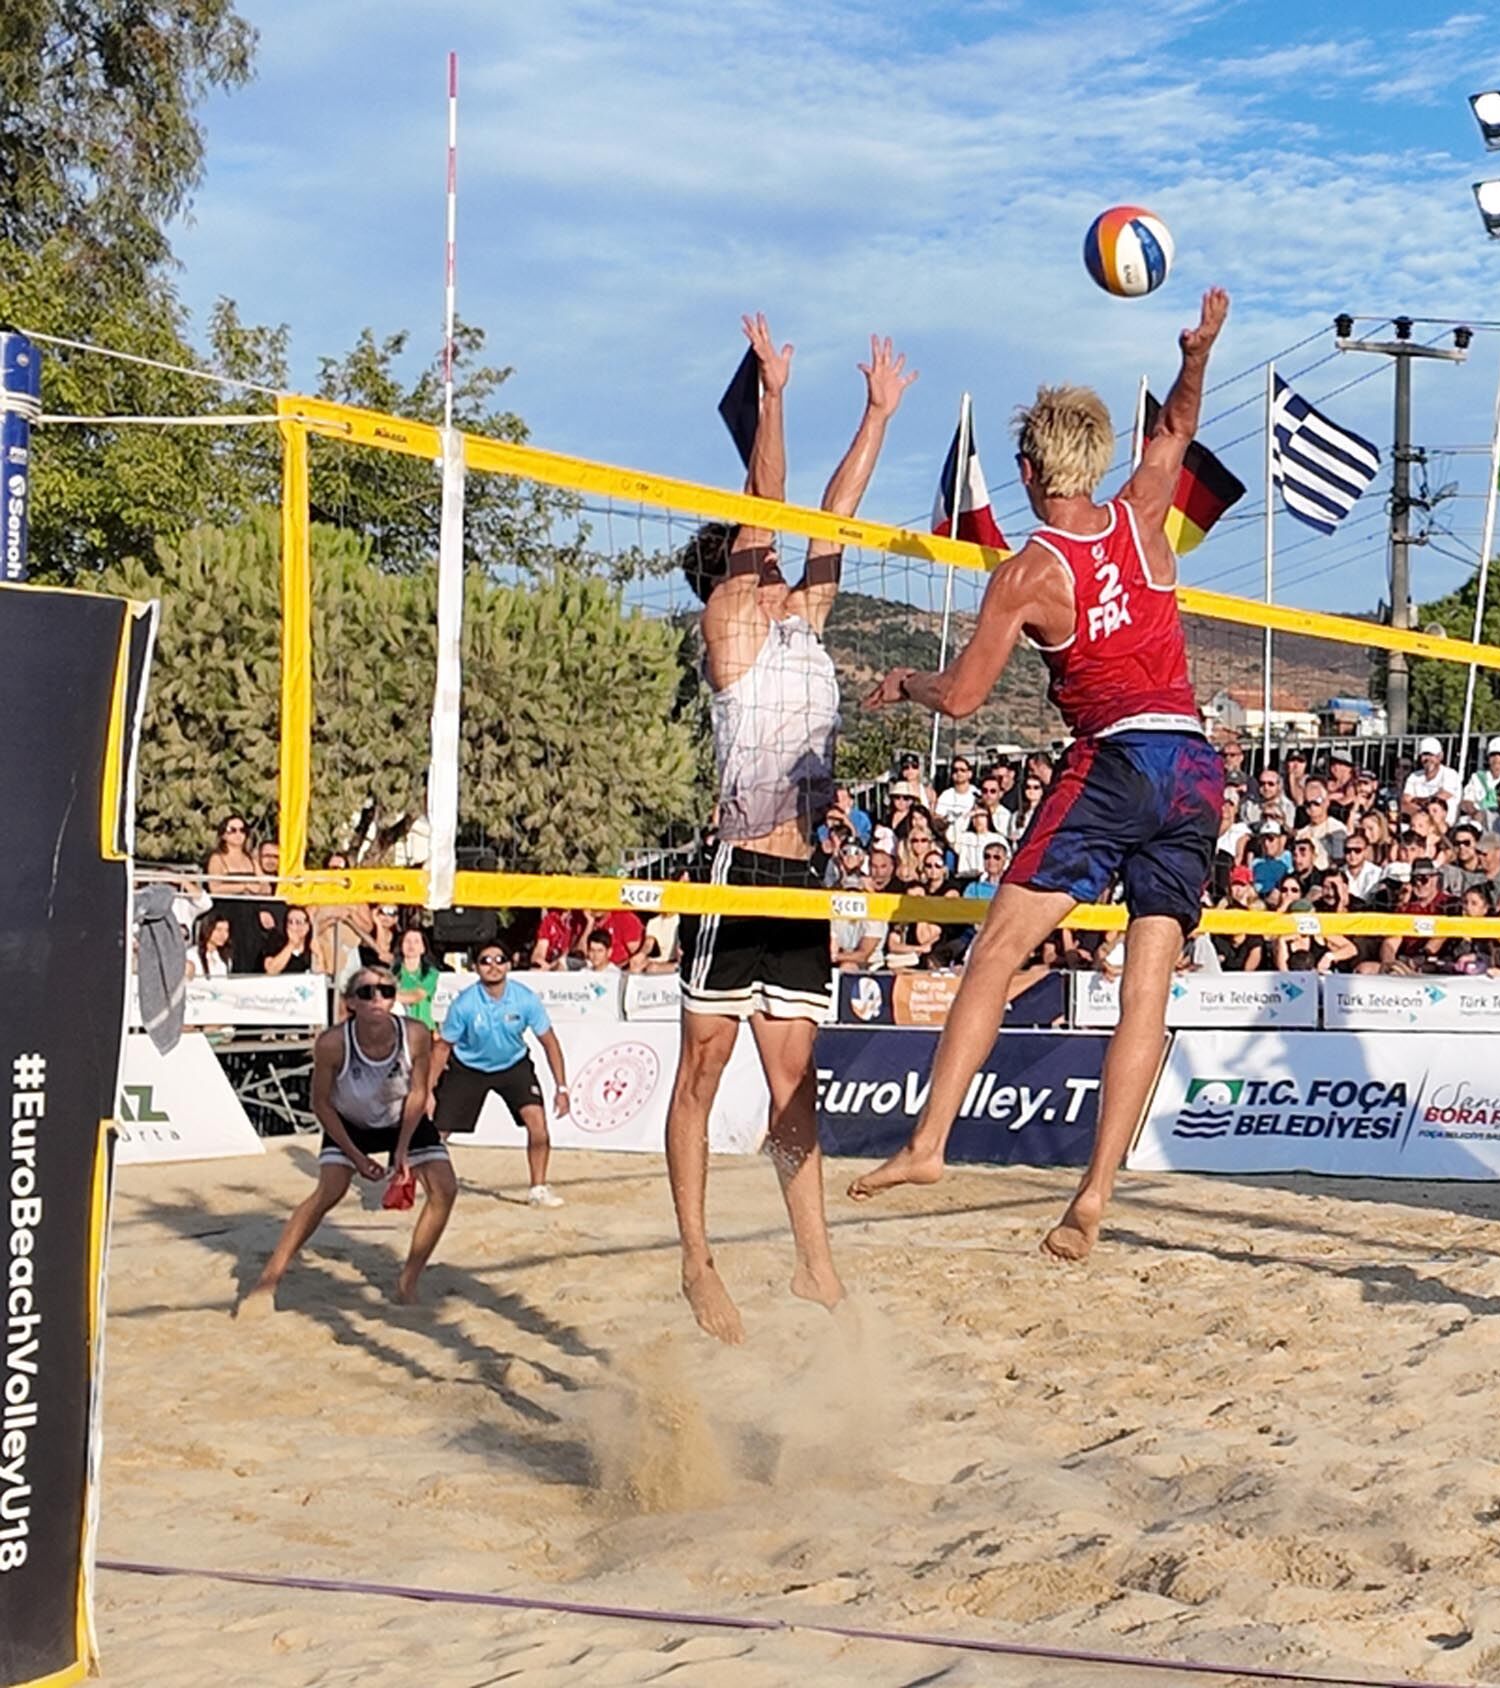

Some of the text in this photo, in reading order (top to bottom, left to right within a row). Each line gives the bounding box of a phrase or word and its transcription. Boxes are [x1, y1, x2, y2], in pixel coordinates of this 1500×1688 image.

[1095, 563, 1123, 605] 2
[1087, 592, 1132, 642] FRA
[1200, 991, 1282, 1004] Türk Telekom
[1337, 993, 1423, 1008] Türk Telekom
[1460, 995, 1487, 1008] Türk
[815, 1069, 1100, 1130] EuroVlley.T
[1246, 1080, 1407, 1114] T.C. FOÇA
[1234, 1111, 1404, 1139] BELEDİYESİ
[1424, 1107, 1487, 1124] BORA
[0, 1053, 46, 1572] #EuroBeachVolleyU18
